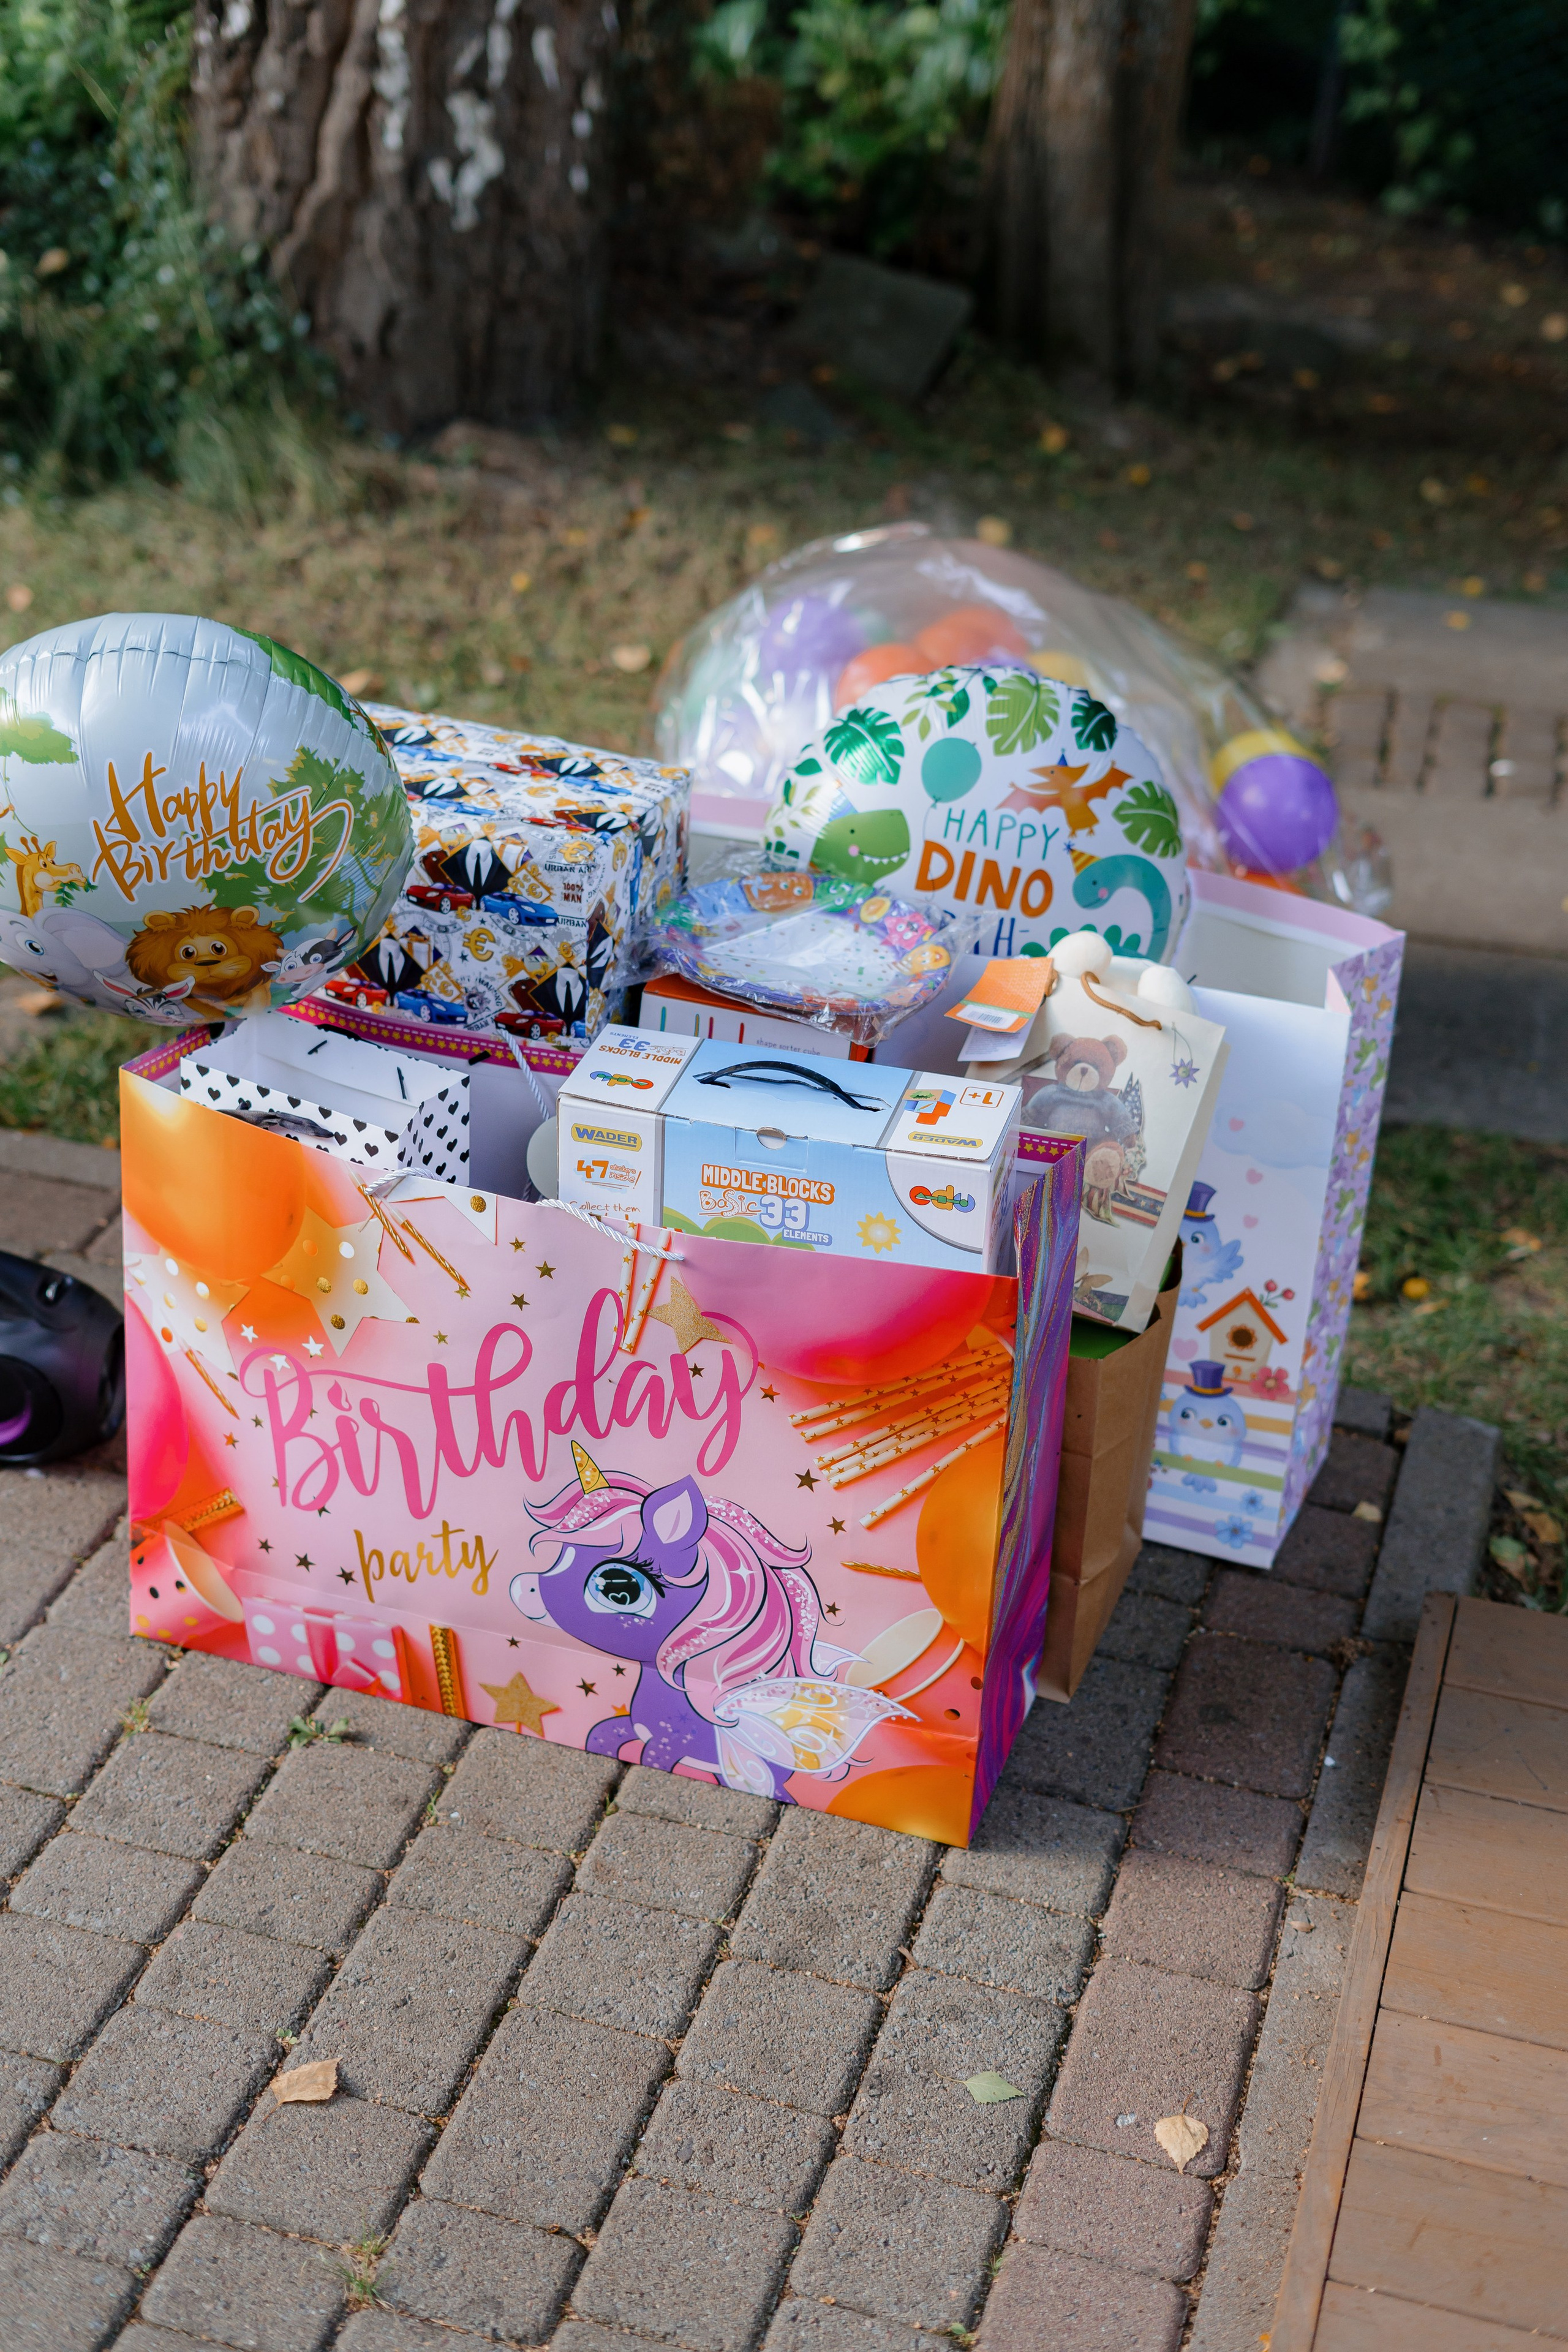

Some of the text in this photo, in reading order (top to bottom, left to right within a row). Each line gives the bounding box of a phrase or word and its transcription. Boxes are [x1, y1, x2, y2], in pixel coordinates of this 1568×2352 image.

[104, 751, 244, 843] Happy
[943, 807, 1060, 861] HAPPY
[92, 787, 354, 903] Birthday
[562, 882, 584, 892] 100%
[914, 840, 1054, 918] DINO
[563, 892, 582, 903] MAN
[598, 1045, 683, 1065] MIDDLE BLOCKS
[618, 1038, 651, 1052] 33
[756, 1037, 821, 1057] shape sorter cube
[575, 1126, 638, 1145] WADER
[911, 1134, 979, 1147] WADER
[577, 1159, 636, 1179] 47 stickers
[703, 1164, 832, 1202] MIDDLE BLOCKS
[612, 1202, 641, 1213] them
[760, 1194, 808, 1231] 33
[783, 1229, 829, 1243] ELEMENTS
[239, 1287, 759, 1520] Birthday
[353, 1520, 499, 1604] party
